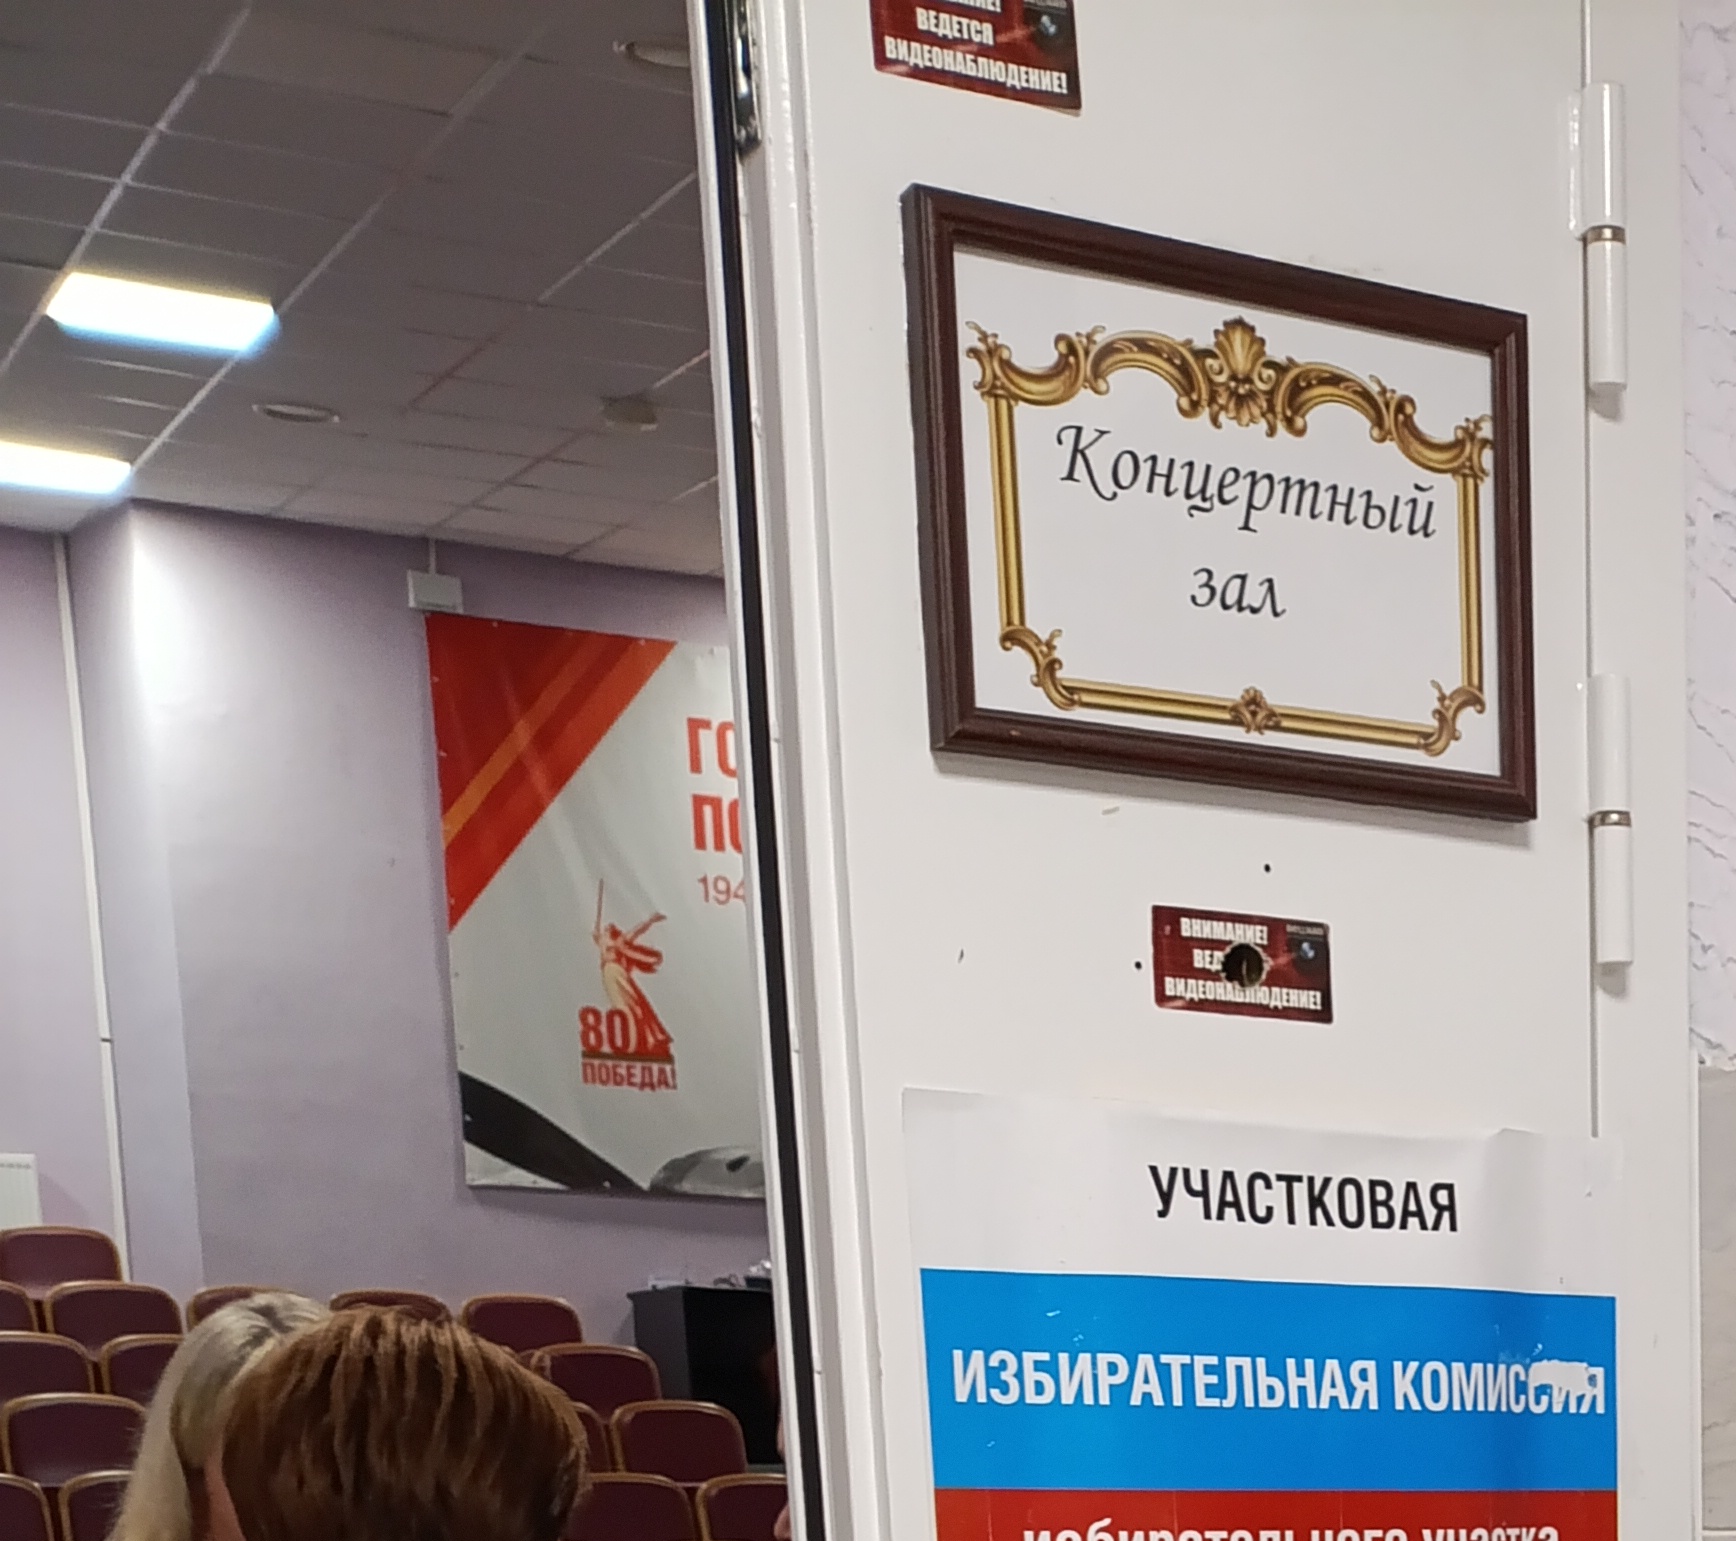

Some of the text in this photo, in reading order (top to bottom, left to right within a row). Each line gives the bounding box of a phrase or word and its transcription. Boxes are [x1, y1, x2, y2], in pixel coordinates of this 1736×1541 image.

[915, 7, 994, 46] ВЕДЕТСЯ
[884, 35, 1068, 94] ВИДЕОНАБЛЮДЕНИЕ!
[1056, 423, 1437, 540] Концертный
[1189, 564, 1288, 620] зал
[1180, 917, 1268, 945] ВНИМАНИЕ!
[579, 1005, 631, 1053] 80
[582, 1060, 678, 1092] ПОБЕДА!
[1147, 1163, 1459, 1233] УЧАСТКОВАЯ
[951, 1348, 1380, 1413] ИЗБИРАТЕЛЬНАЯ
